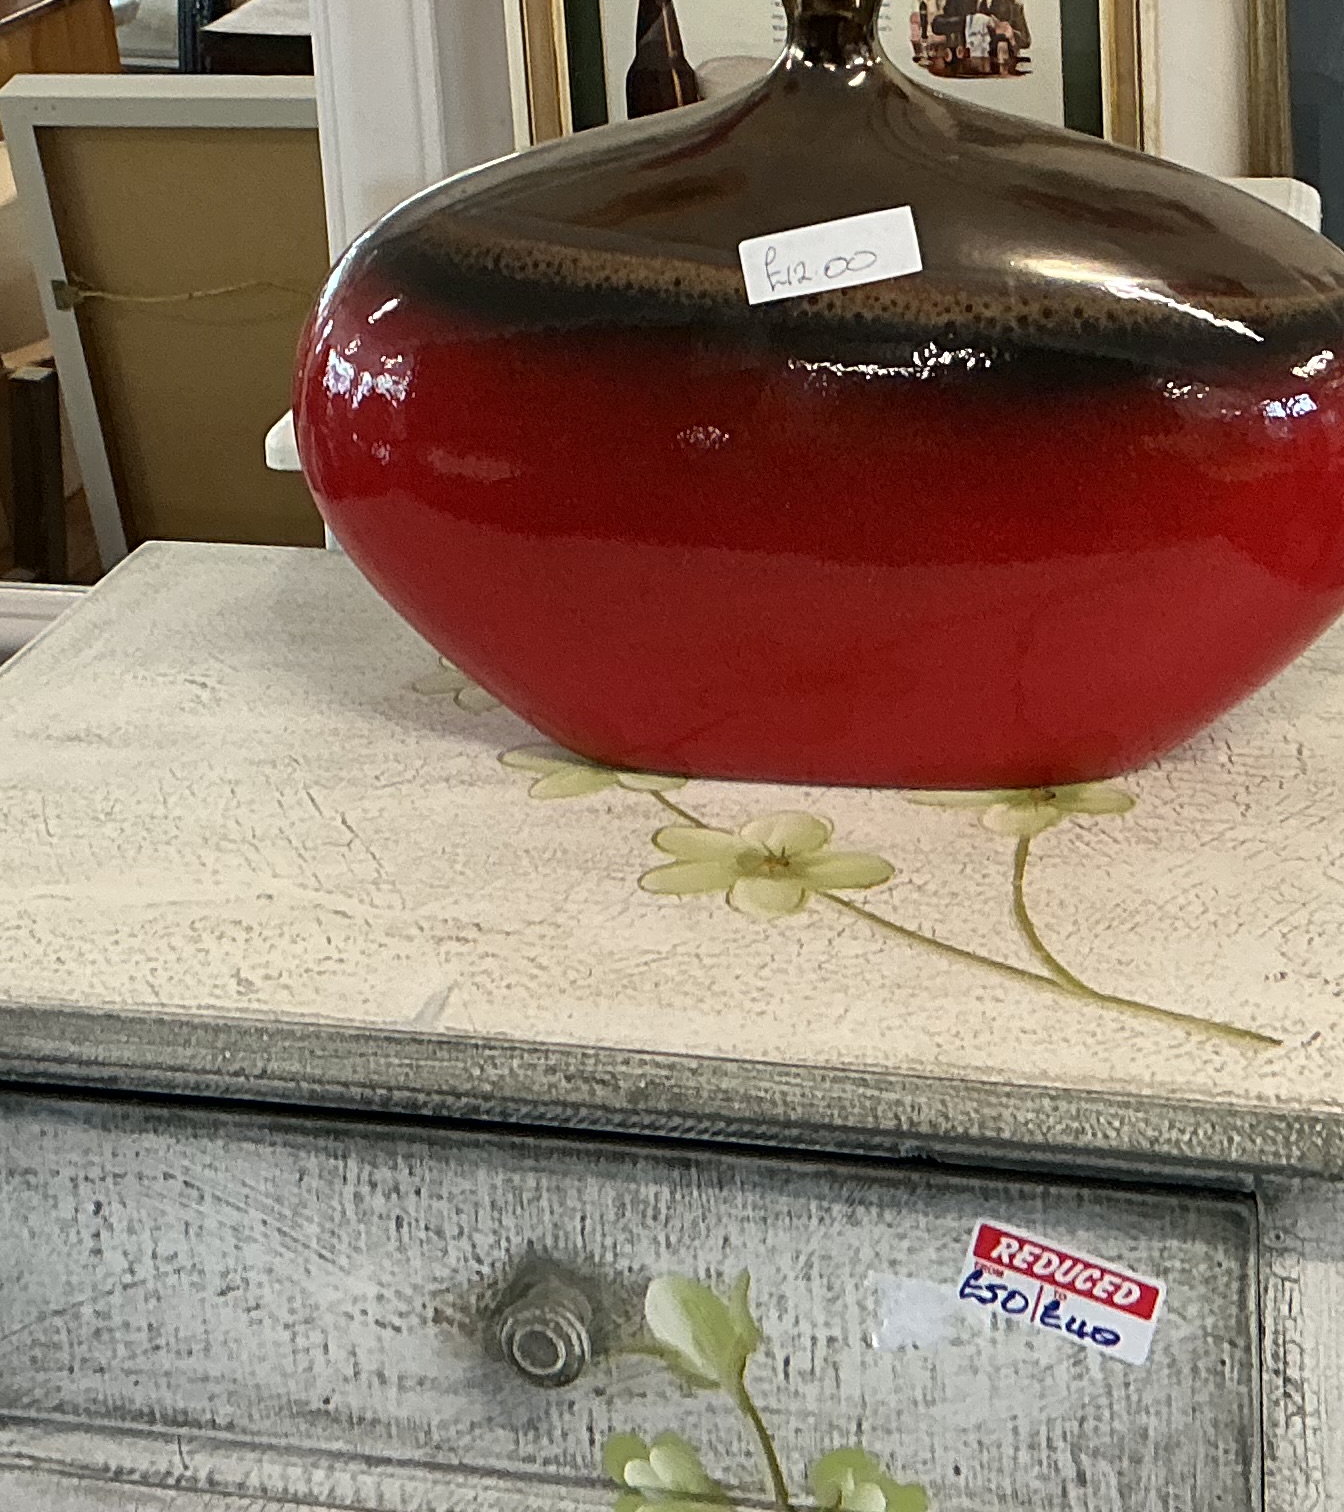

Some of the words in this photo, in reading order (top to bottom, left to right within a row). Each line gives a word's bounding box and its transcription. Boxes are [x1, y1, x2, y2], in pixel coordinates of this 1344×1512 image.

[959, 1269, 1030, 1315] £50
[1039, 1298, 1121, 1348] £40
[990, 1235, 1142, 1307] REDUCED
